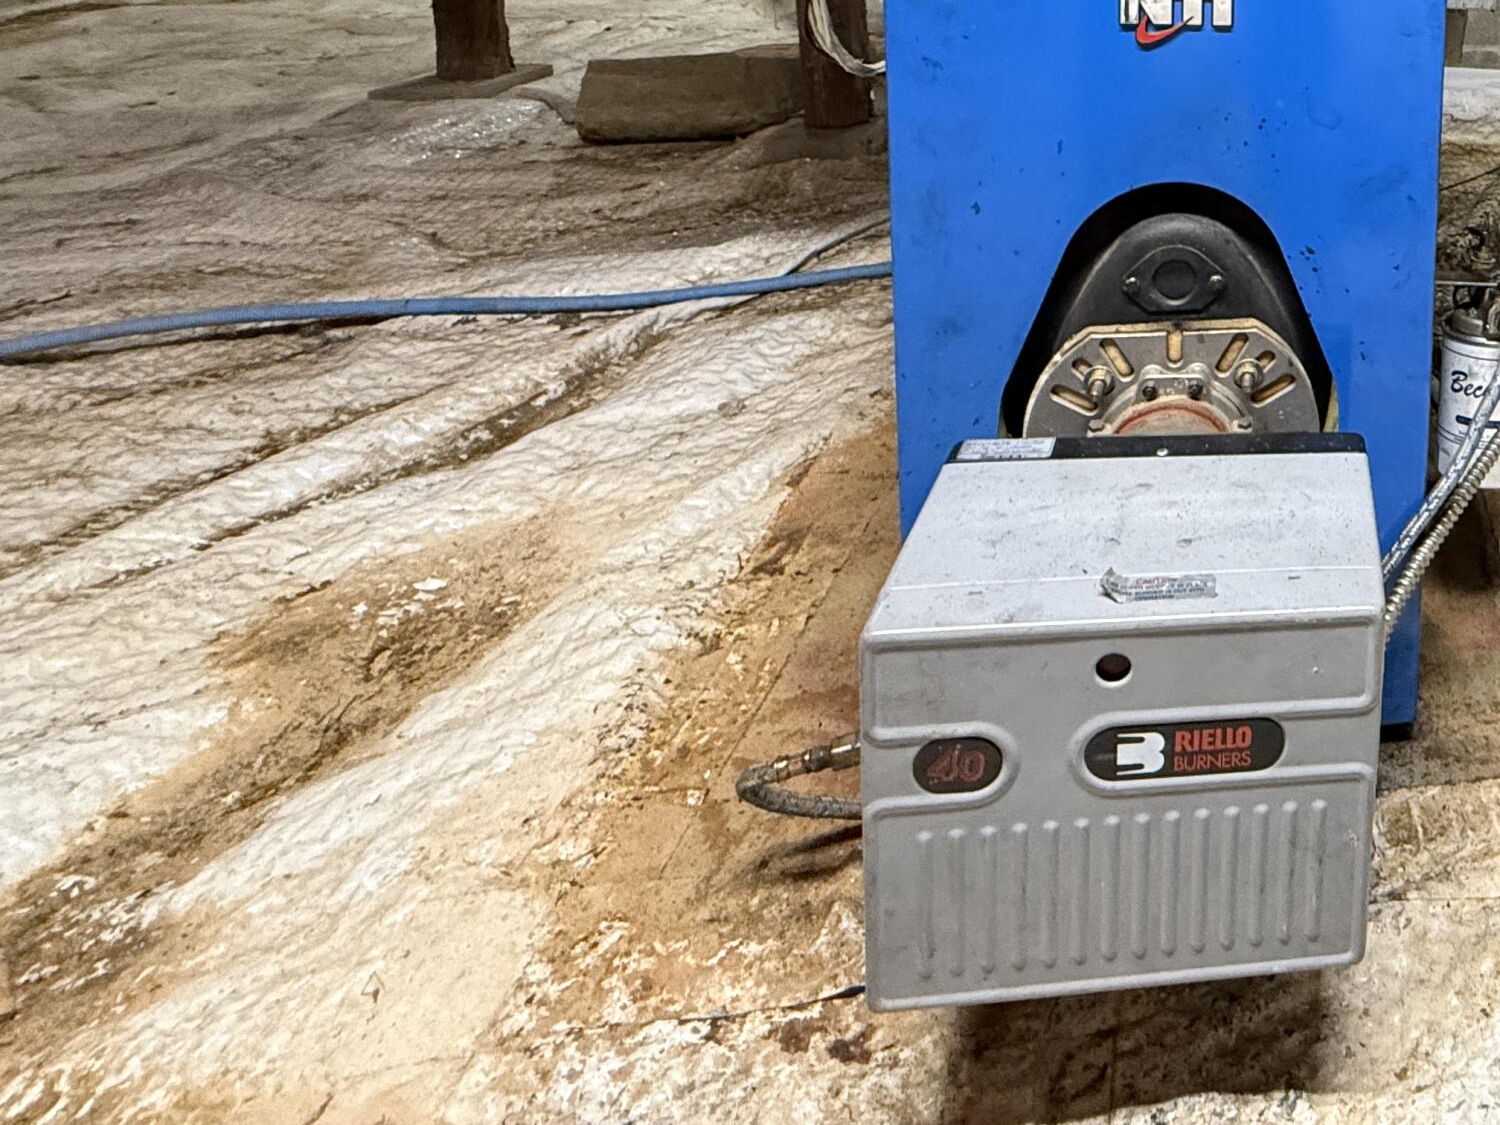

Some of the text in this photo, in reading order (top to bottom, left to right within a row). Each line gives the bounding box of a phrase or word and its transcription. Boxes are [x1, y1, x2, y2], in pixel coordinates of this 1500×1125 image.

[1174, 725, 1253, 752] RIELLO
[926, 749, 986, 783] 40
[1173, 749, 1252, 772] BURNERS
